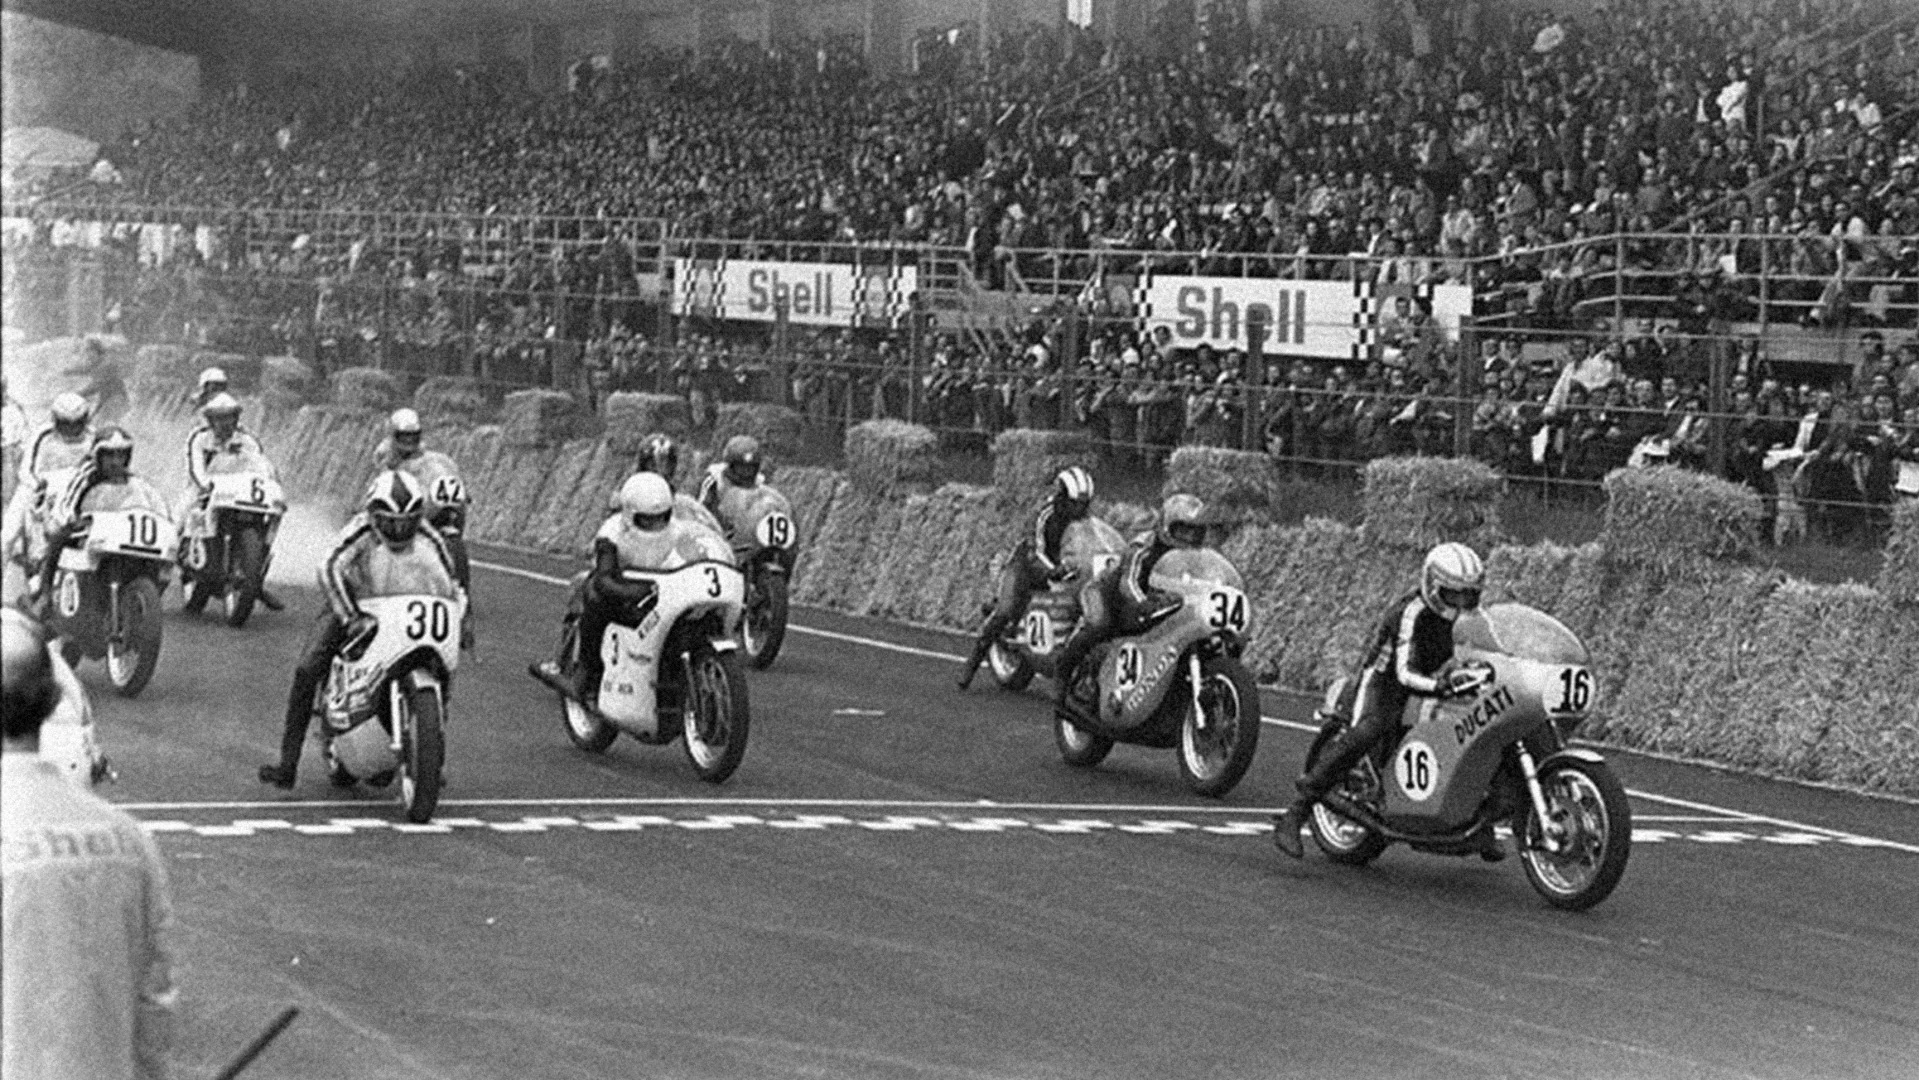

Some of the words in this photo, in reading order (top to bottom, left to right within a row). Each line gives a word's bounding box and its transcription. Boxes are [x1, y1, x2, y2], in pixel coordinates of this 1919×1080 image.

[749, 268, 832, 317] Shell
[1176, 286, 1305, 343] Shell
[251, 478, 265, 503] 6
[436, 479, 461, 503] 42
[128, 514, 157, 546] 10
[768, 516, 788, 545] 19
[704, 567, 722, 598] 3
[406, 600, 449, 642] 30
[1029, 615, 1046, 647] 21
[1209, 592, 1245, 632] 34
[1118, 648, 1138, 685] 34
[1557, 667, 1591, 713] 16
[1454, 686, 1514, 744] DUCATI
[1404, 749, 1429, 791] 16
